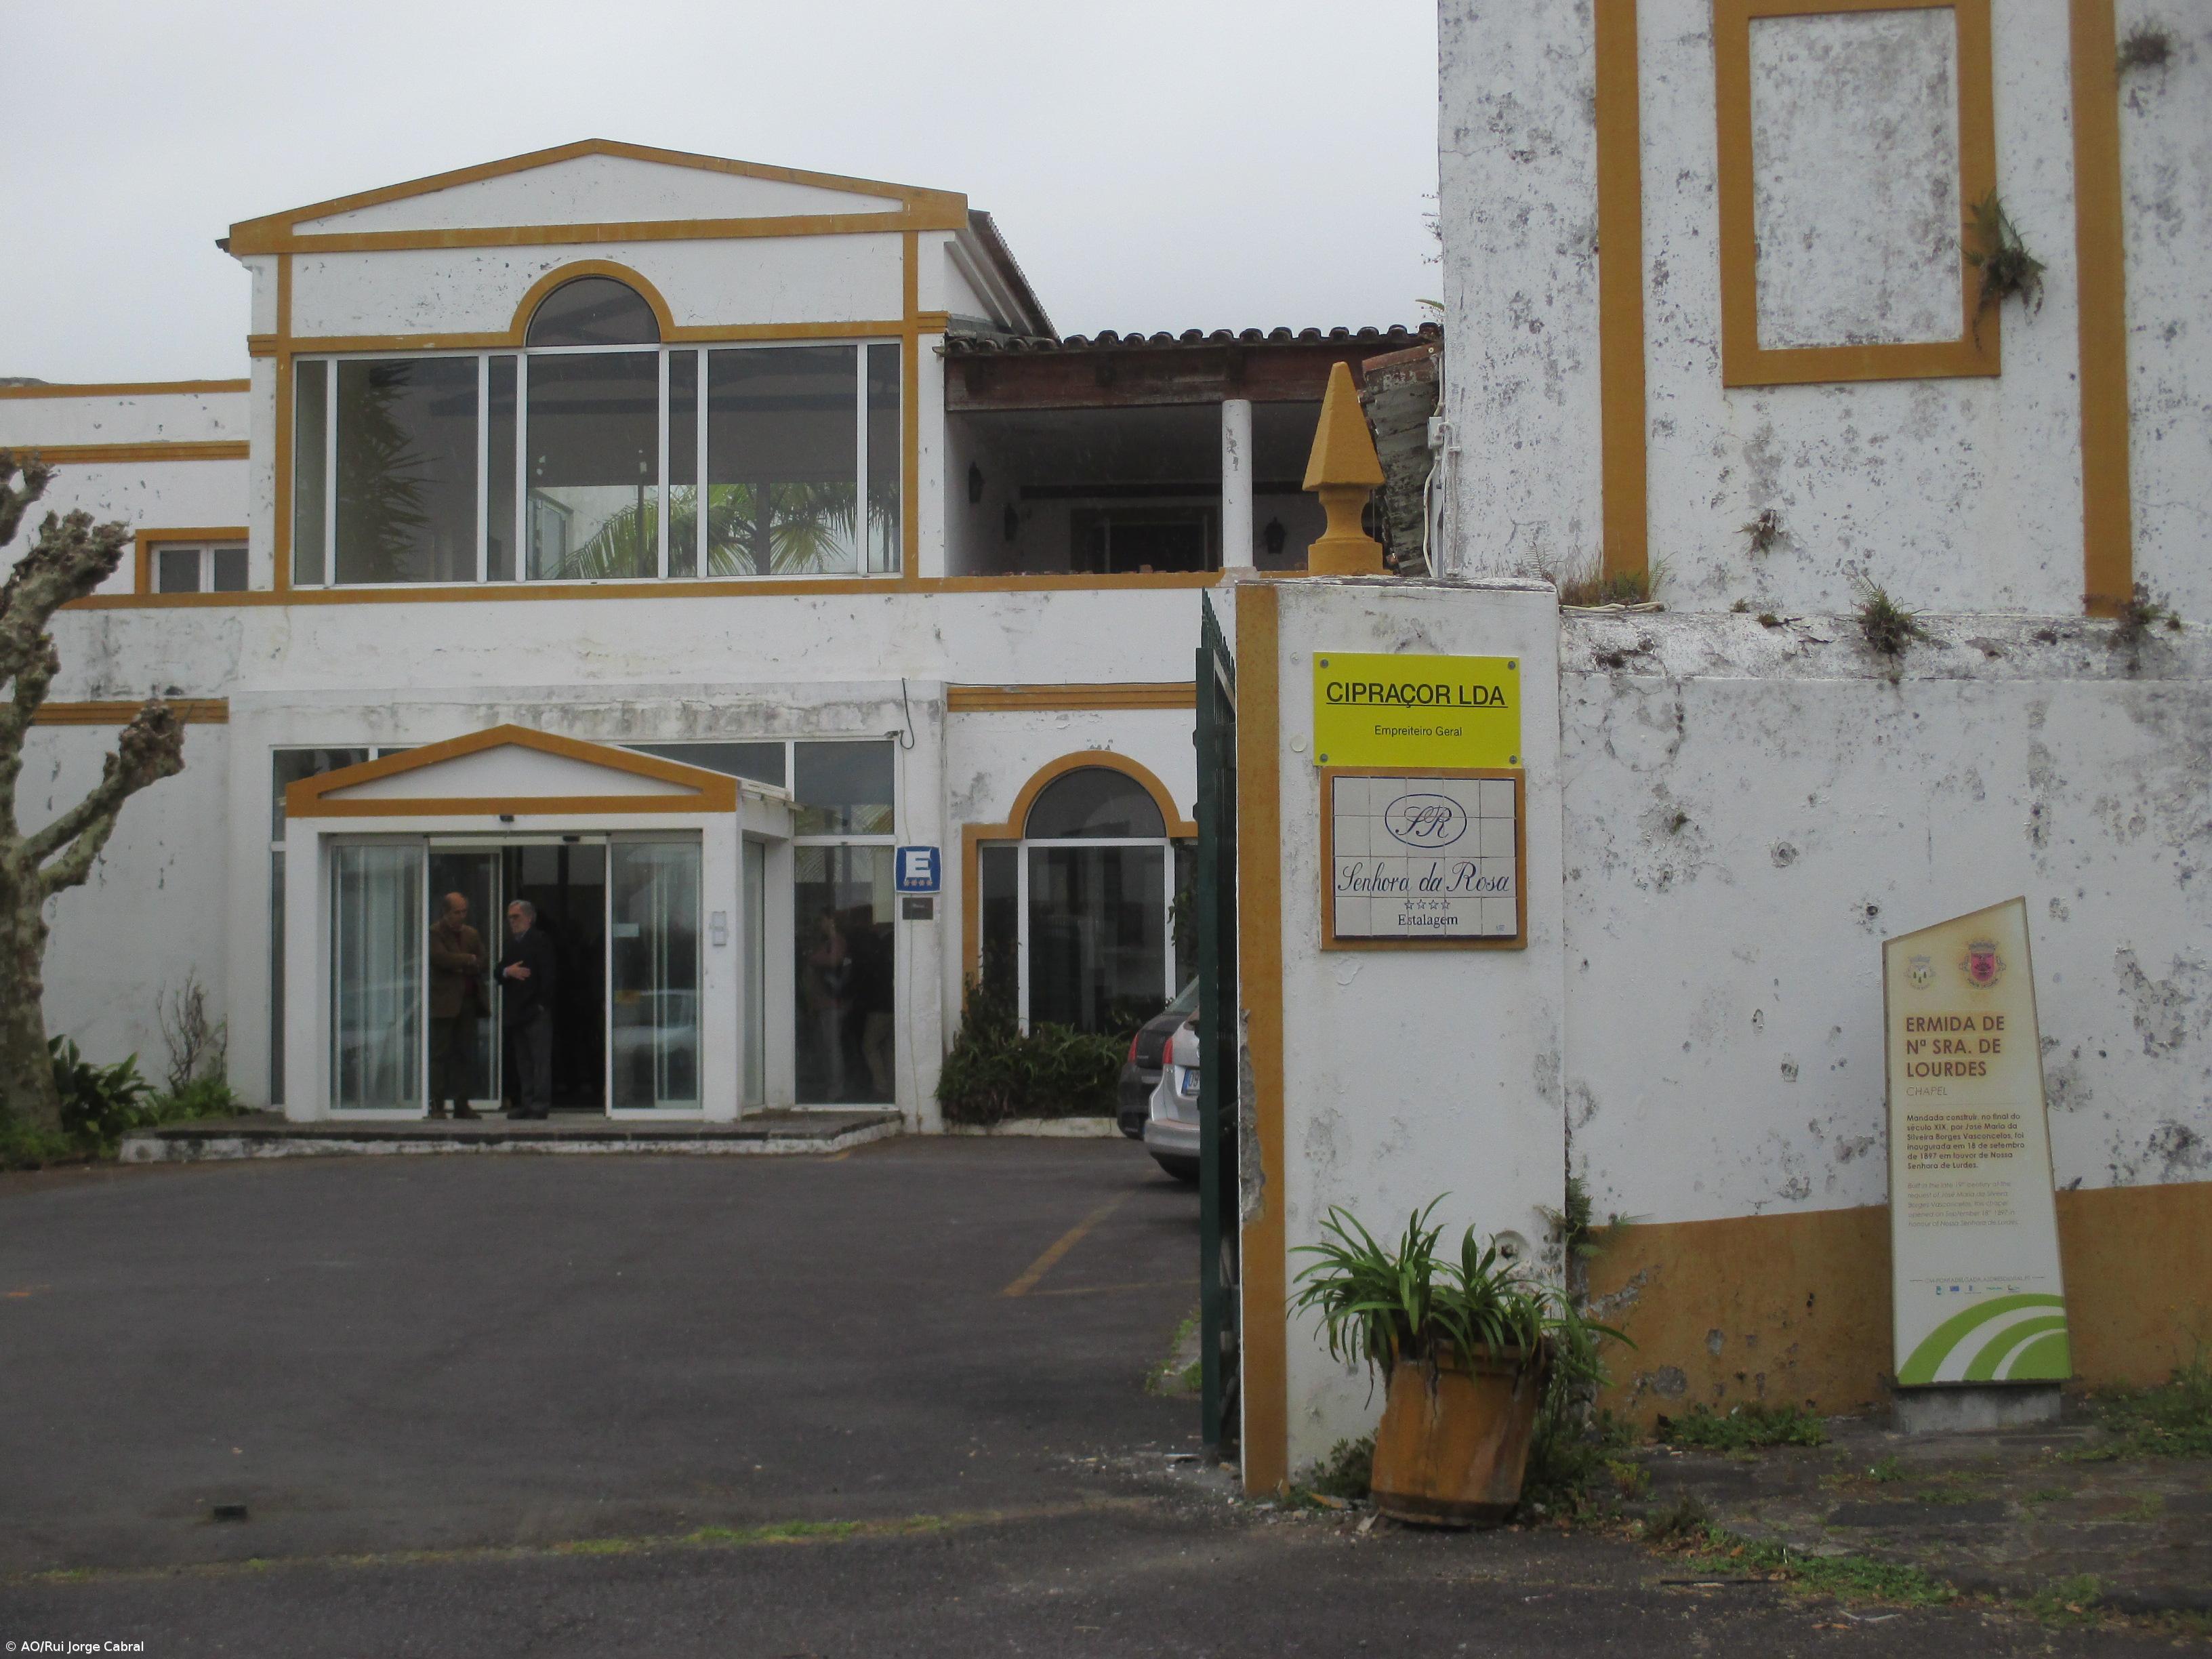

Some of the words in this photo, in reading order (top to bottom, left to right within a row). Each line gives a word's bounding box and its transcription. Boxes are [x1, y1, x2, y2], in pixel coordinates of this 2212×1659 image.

[1326, 682, 1451, 708] CIPRAÇOR
[1458, 684, 1505, 705] LDA
[1374, 725, 1433, 737] Empreiteiro
[1435, 726, 1462, 737] Geral
[905, 848, 931, 880] E
[1338, 862, 1410, 892] Senhora
[1419, 862, 1443, 892] da
[1446, 861, 1510, 892] Rosa
[1398, 914, 1458, 928] Estalagem
[1906, 1017, 1975, 1031] ERMIDA
[1983, 1016, 2004, 1031] DE
[1933, 1039, 1971, 1054] SRA.
[1979, 1038, 2001, 1053] DE
[1907, 1061, 1986, 1077] LOURDES
[1906, 1086, 1948, 1096] CHAPEL
[1936, 1133, 1961, 1141] Borges
[1907, 1143, 1950, 1151] inaugurada
